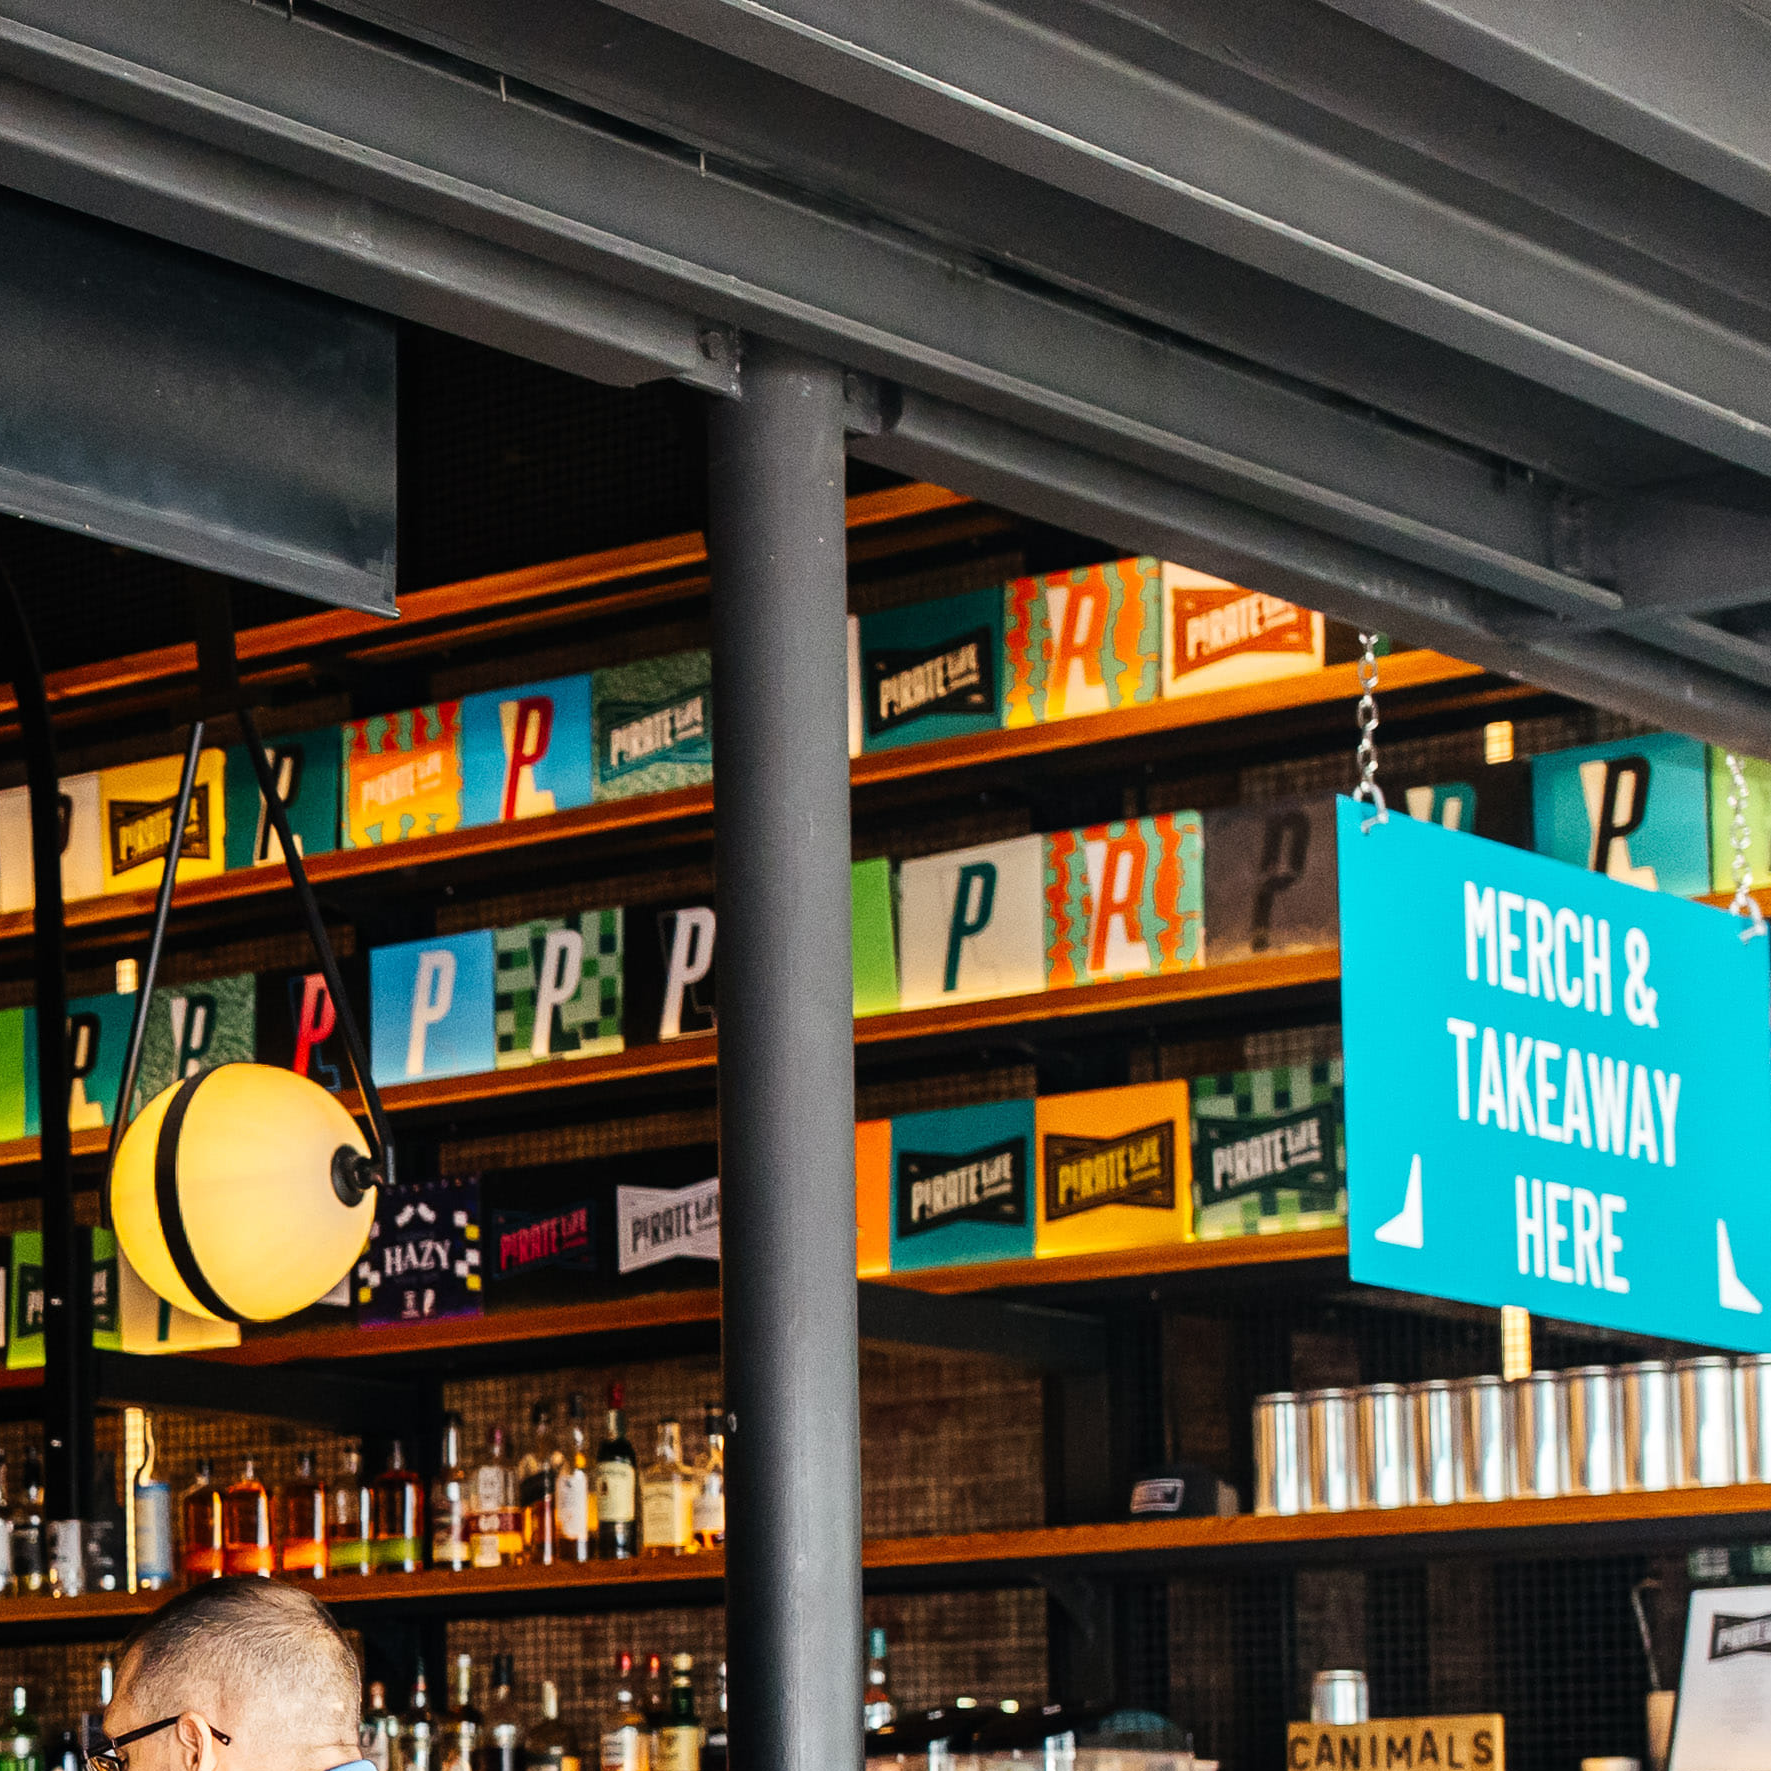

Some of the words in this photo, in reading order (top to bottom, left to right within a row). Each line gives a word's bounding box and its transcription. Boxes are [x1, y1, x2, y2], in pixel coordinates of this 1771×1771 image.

[504, 696, 554, 820] P
[660, 906, 716, 1040] P
[944, 861, 997, 992] P
[1464, 881, 1612, 1016] MERCH
[1624, 928, 1659, 1029] &
[406, 949, 456, 1077] P
[531, 930, 583, 1058] P
[1447, 1017, 1681, 1167] TAKEAWAY
[384, 1239, 451, 1278] HAZY
[1515, 1175, 1630, 1294] HERE
[1288, 1728, 1494, 1771] CANIMALS
